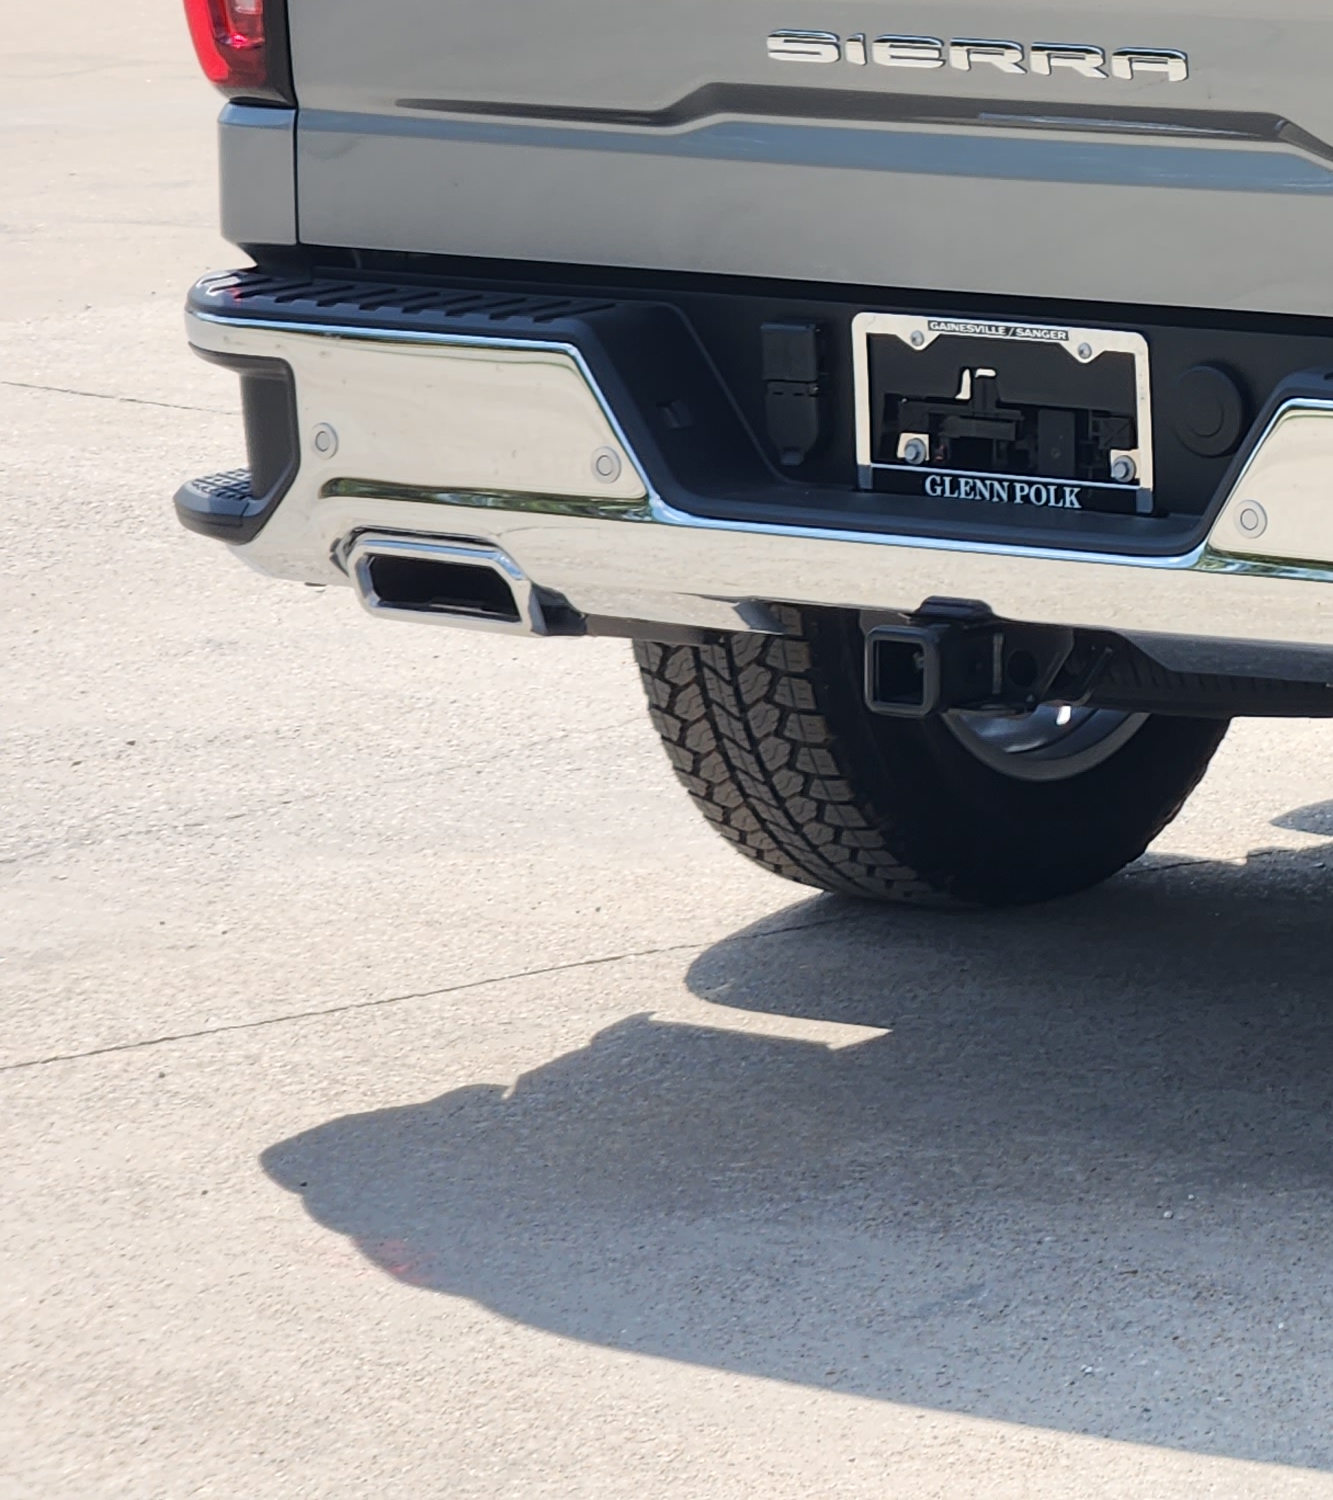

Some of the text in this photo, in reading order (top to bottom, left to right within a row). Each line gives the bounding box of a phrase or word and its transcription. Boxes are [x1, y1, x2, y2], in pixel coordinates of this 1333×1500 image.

[766, 29, 1190, 82] SIERRA
[929, 321, 1007, 336] GAINESVILLE
[1015, 327, 1067, 340] SANGER
[924, 474, 1082, 509] GLENN POLK
